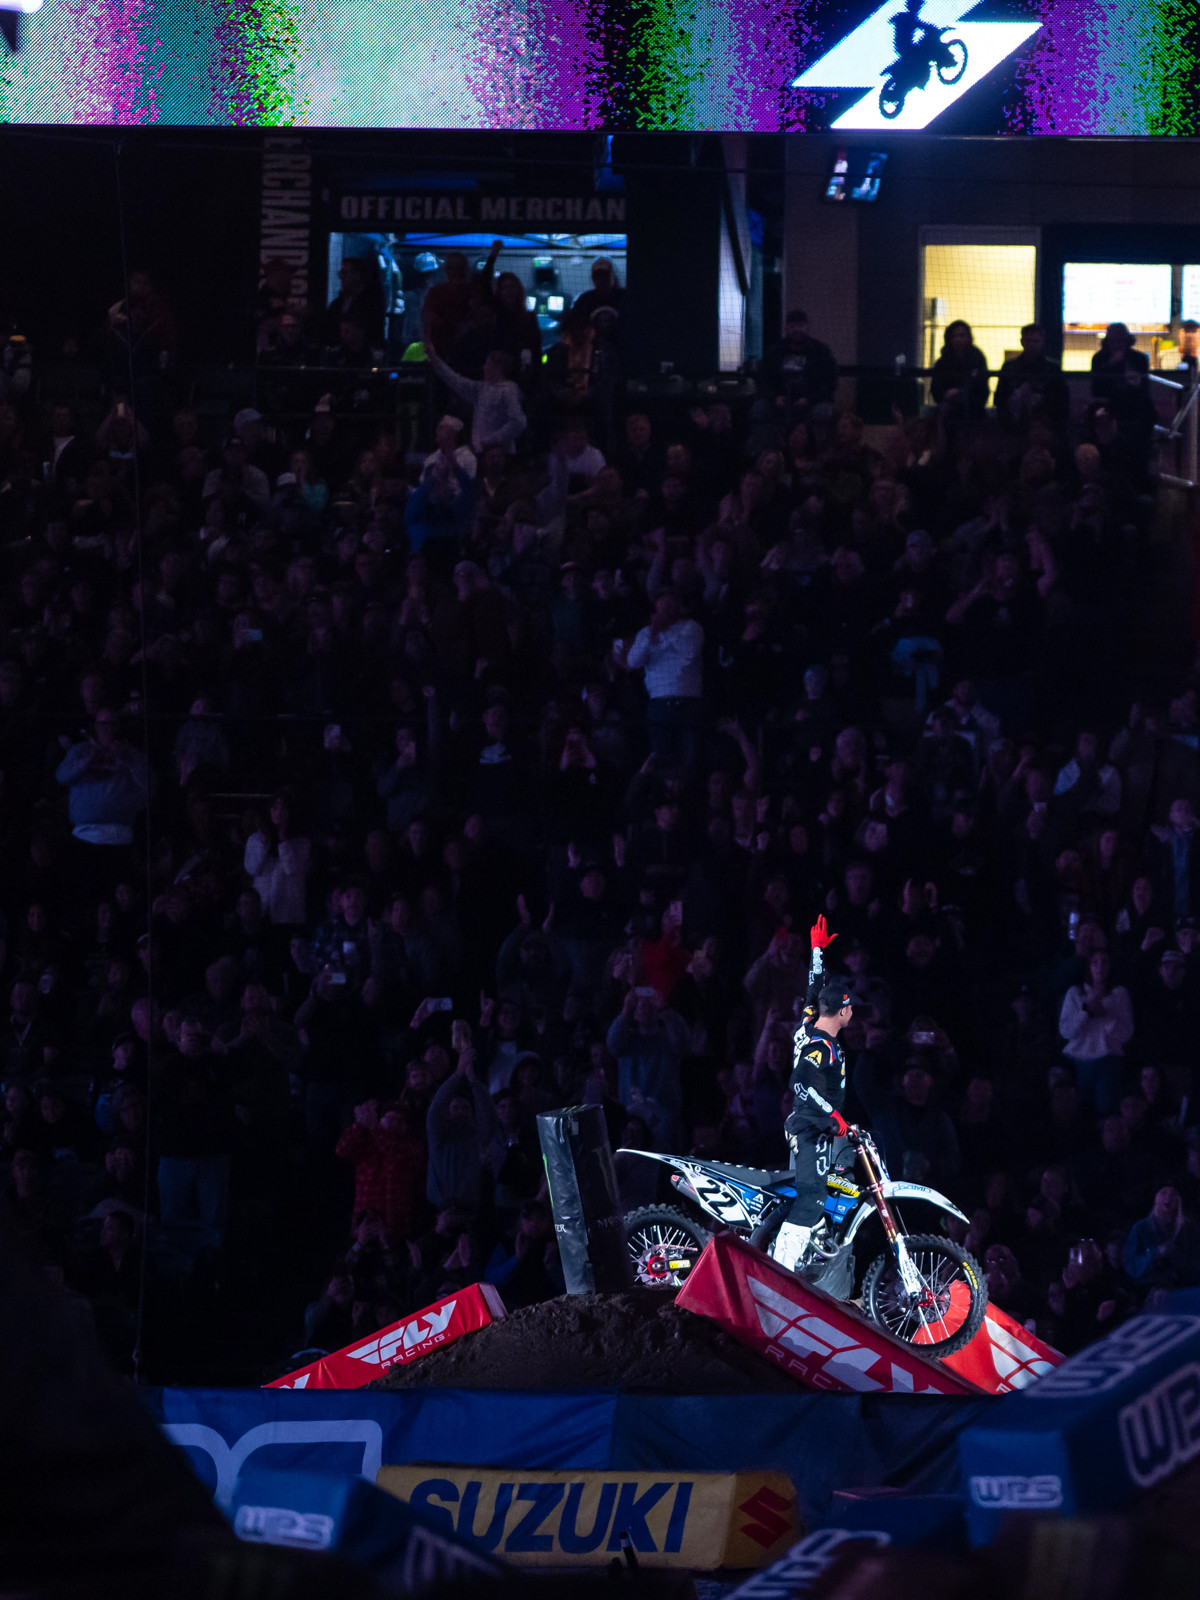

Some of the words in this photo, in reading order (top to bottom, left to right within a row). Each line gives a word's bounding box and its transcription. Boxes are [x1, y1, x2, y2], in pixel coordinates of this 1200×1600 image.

[258, 131, 312, 306] ERCHAND
[340, 196, 471, 221] OFFICIAL
[696, 1179, 738, 1216] 22
[380, 1333, 446, 1370] RACING
[969, 1474, 1064, 1509] WPS
[409, 1478, 694, 1553] SUZUKI
